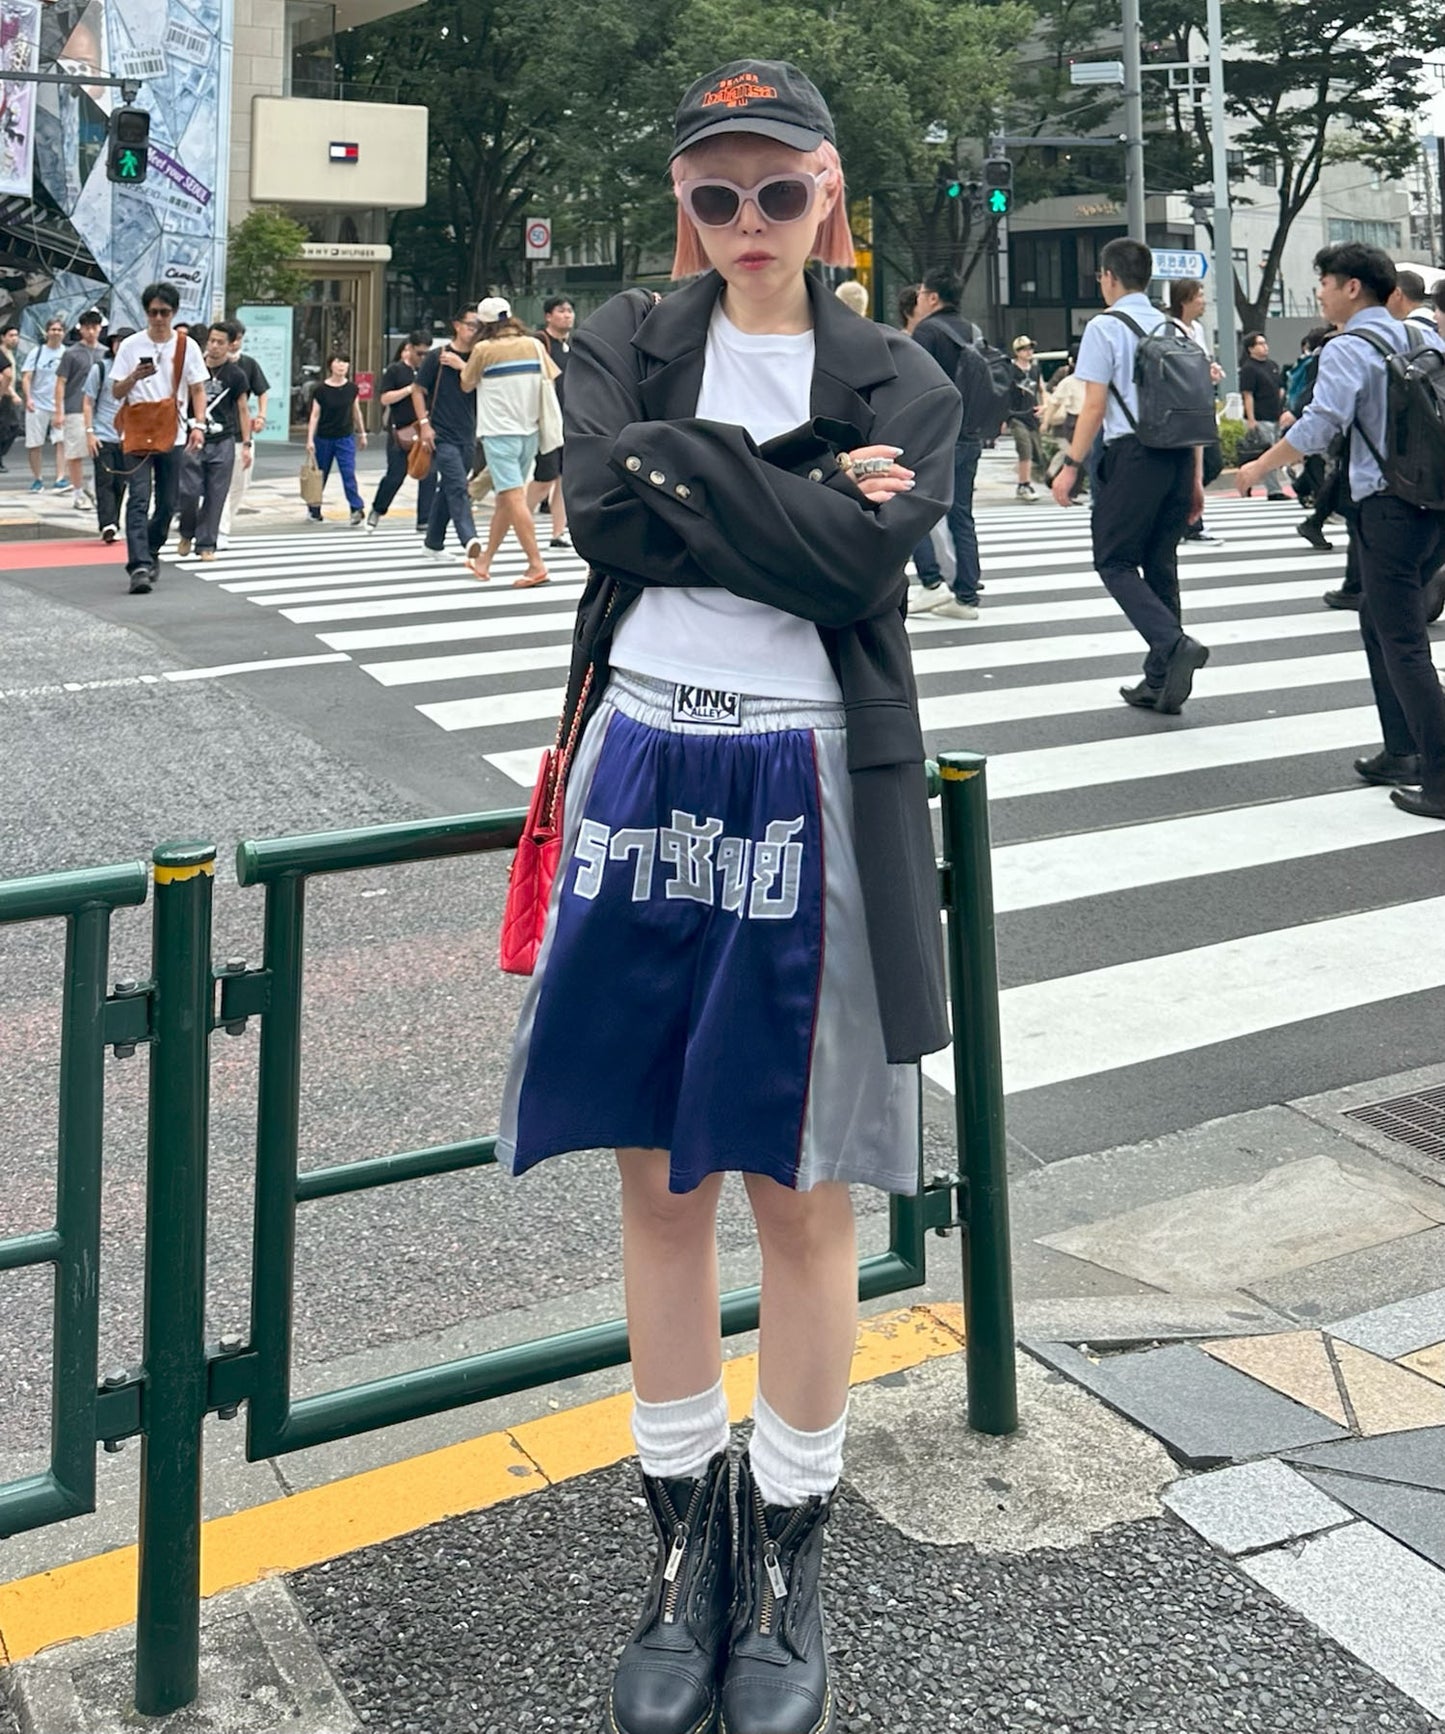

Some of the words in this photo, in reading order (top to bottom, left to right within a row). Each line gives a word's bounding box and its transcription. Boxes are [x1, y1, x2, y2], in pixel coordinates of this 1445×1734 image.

[182, 176, 208, 203] SEOUL
[1156, 254, 1197, 269] 明治通り
[678, 684, 739, 716] KING
[690, 706, 723, 719] ALLEY
